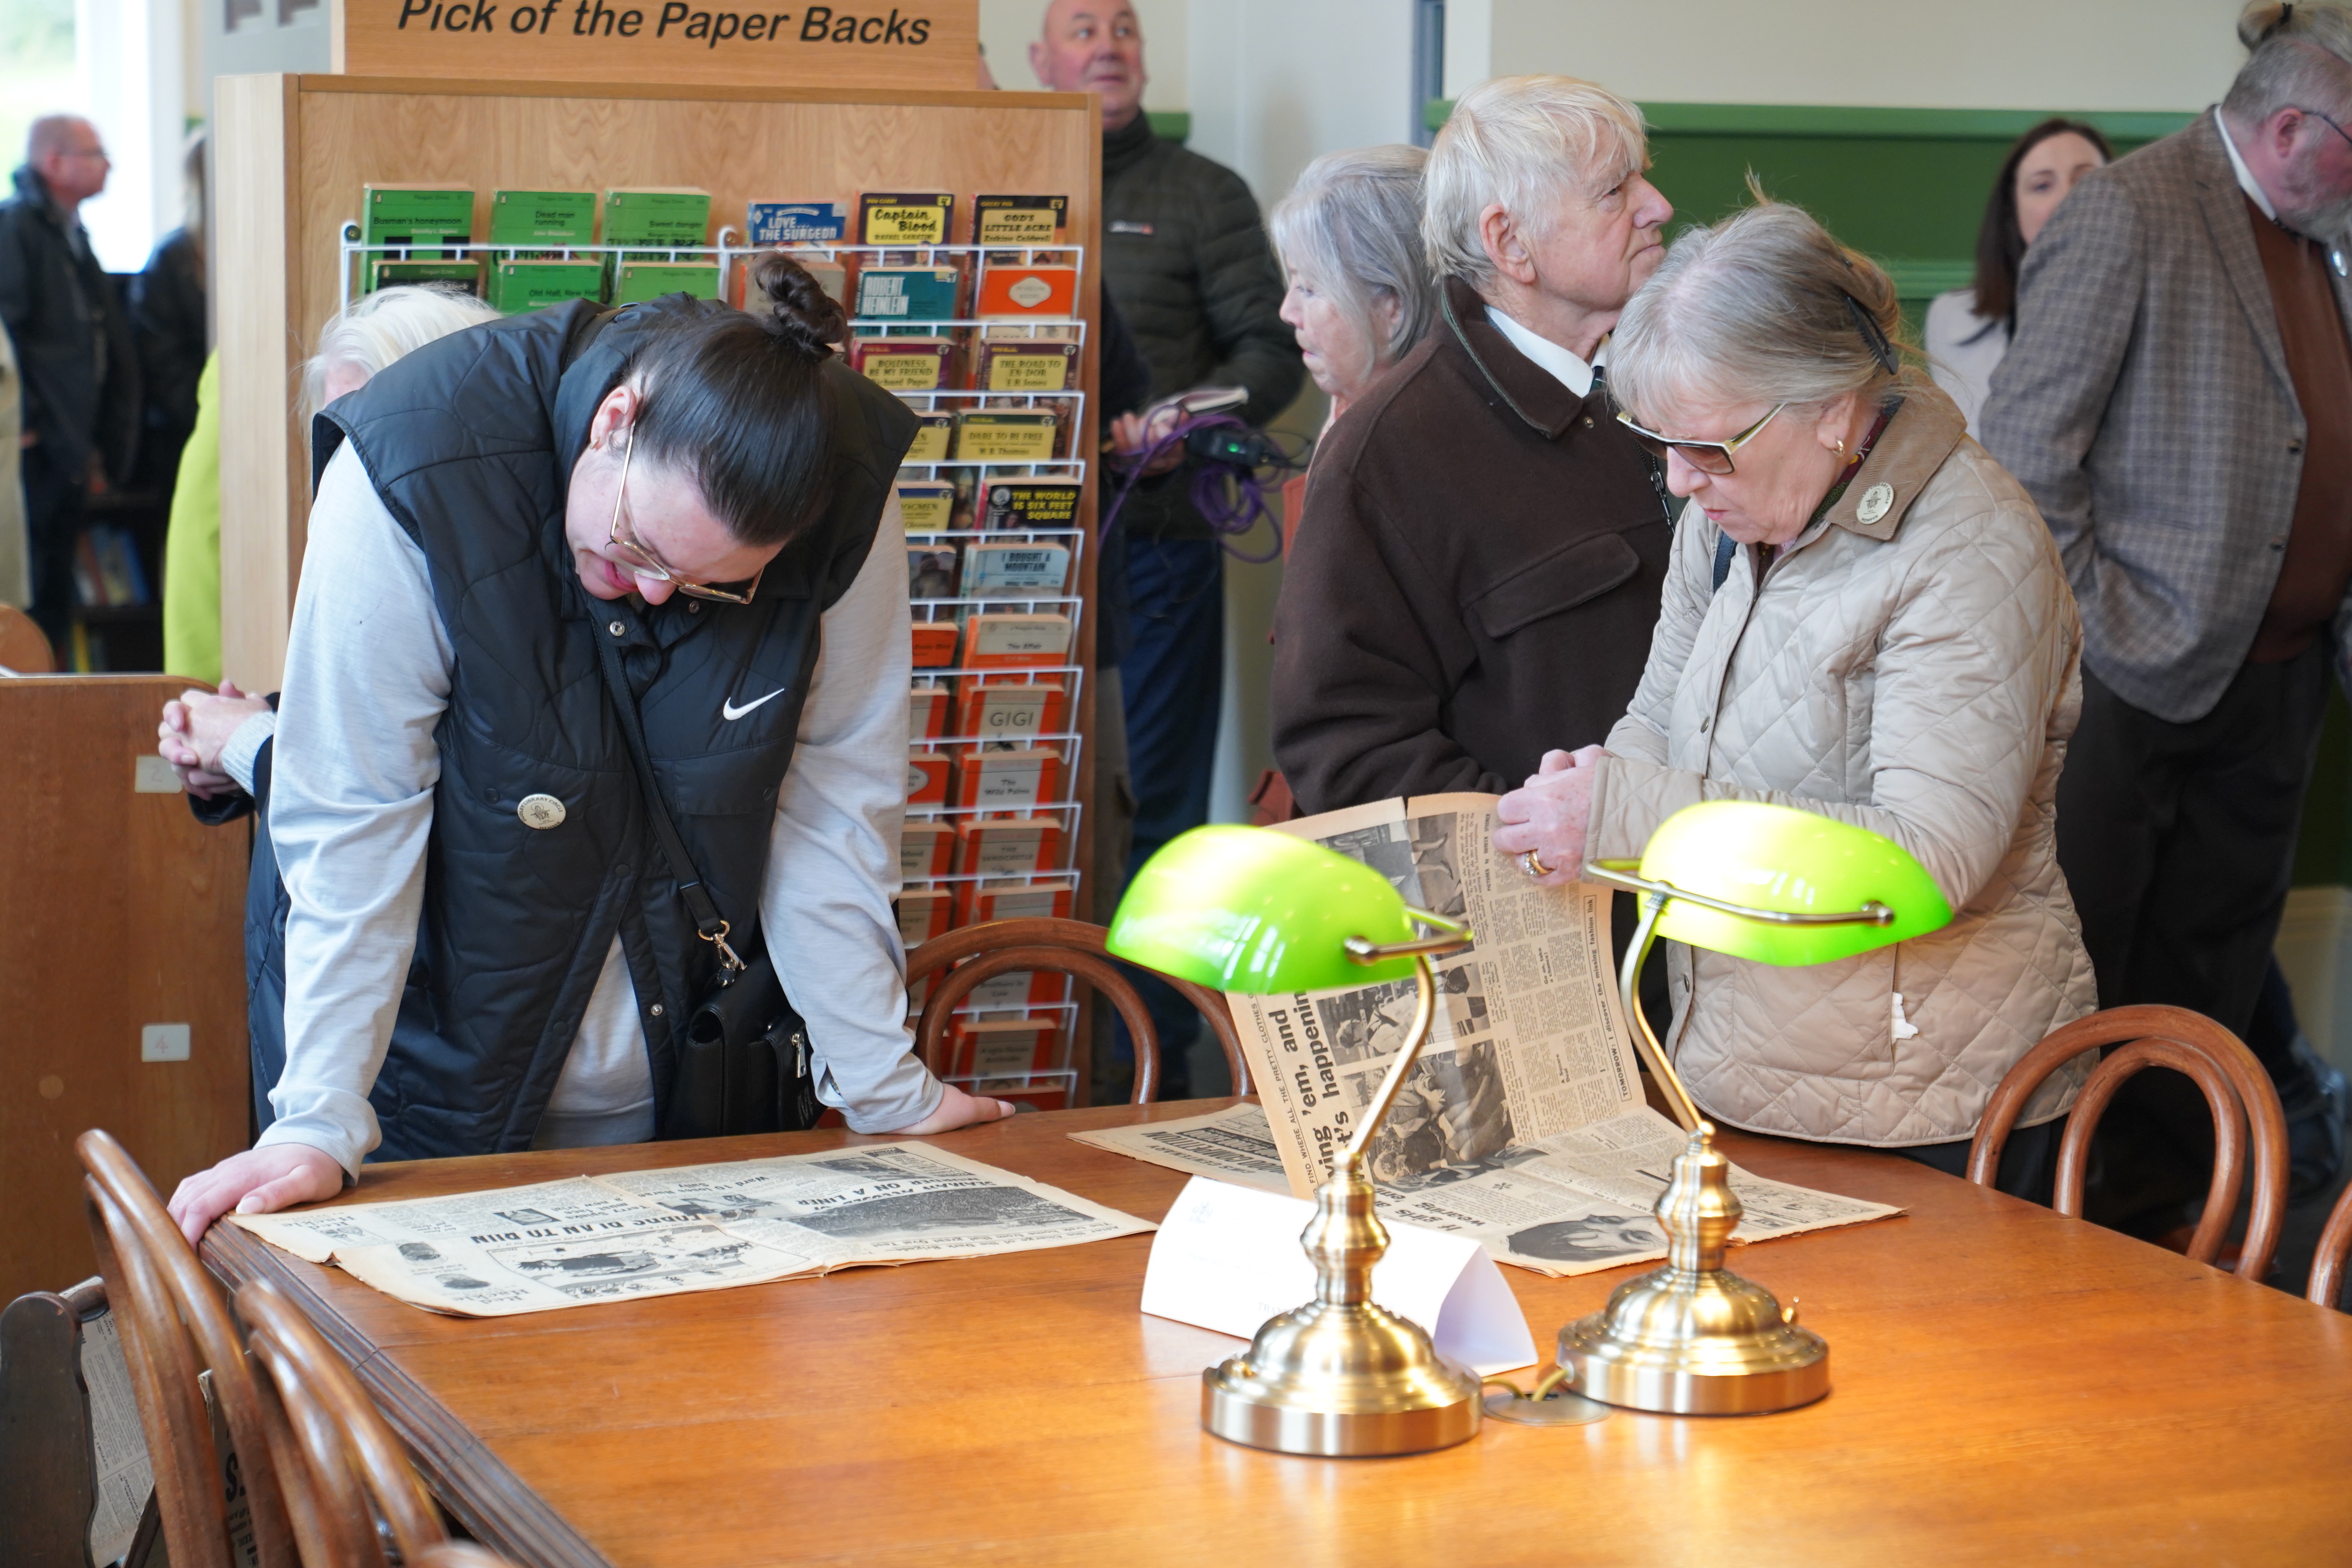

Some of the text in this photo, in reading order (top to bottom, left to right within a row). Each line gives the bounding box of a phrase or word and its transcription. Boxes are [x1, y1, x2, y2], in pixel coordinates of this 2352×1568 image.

[398, 0, 931, 49] Pick of the Paper Backs
[415, 218, 462, 226] honeymoon
[874, 209, 931, 223] Captain
[768, 216, 810, 229] LOVE...
[898, 220, 939, 232] Blood
[759, 227, 838, 241] THE SURGEON
[864, 276, 905, 296] ROBERT
[878, 360, 927, 368] BOLDNESS
[1000, 360, 1061, 369] THE ROAD TO
[1009, 369, 1047, 377] EN-DOR
[969, 432, 992, 440] DARE
[1022, 432, 1043, 440] FREE
[1012, 491, 1076, 501] THE WORLD
[1013, 501, 1073, 510] IS SIX FEET
[1027, 511, 1072, 520] SQUARE
[1009, 553, 1043, 562] BOUGHT
[1004, 563, 1047, 572] MOUNTAIN
[990, 712, 1034, 727] GIGI
[518, 797, 564, 822] DUDLEY LIBRARY CIRCLE
[1587, 917, 1596, 945] fashion
[1544, 951, 1553, 978] chance!
[1590, 948, 1601, 979] missing
[1600, 1000, 1612, 1033] discover
[1268, 1009, 1298, 1053] and
[154, 1034, 169, 1054] 4
[1612, 1044, 1628, 1098] TOMORROW:
[1251, 1003, 1316, 1184] FIND WHERE ALL THE PRETTY CLOTHES
[1294, 1063, 1317, 1116] 'em,
[1140, 1131, 1255, 1165] COMPETITION
[1146, 1144, 1223, 1168] CENTENARY
[734, 1175, 770, 1187] Ward
[852, 1187, 866, 1196] A
[873, 1183, 902, 1192] ON
[636, 1190, 676, 1198] Nurse
[795, 1194, 847, 1206] LINER
[597, 1202, 629, 1211] must
[564, 1205, 650, 1221] Terry Spinks
[1394, 1208, 1444, 1224] girls
[1412, 1202, 1487, 1227] wearing
[281, 1215, 356, 1227] Hackle
[308, 1221, 349, 1230] Red
[1091, 1225, 1119, 1234] After
[1020, 1235, 1064, 1243] Charge
[452, 1289, 530, 1301] Hackle
[479, 1296, 523, 1305] Red
